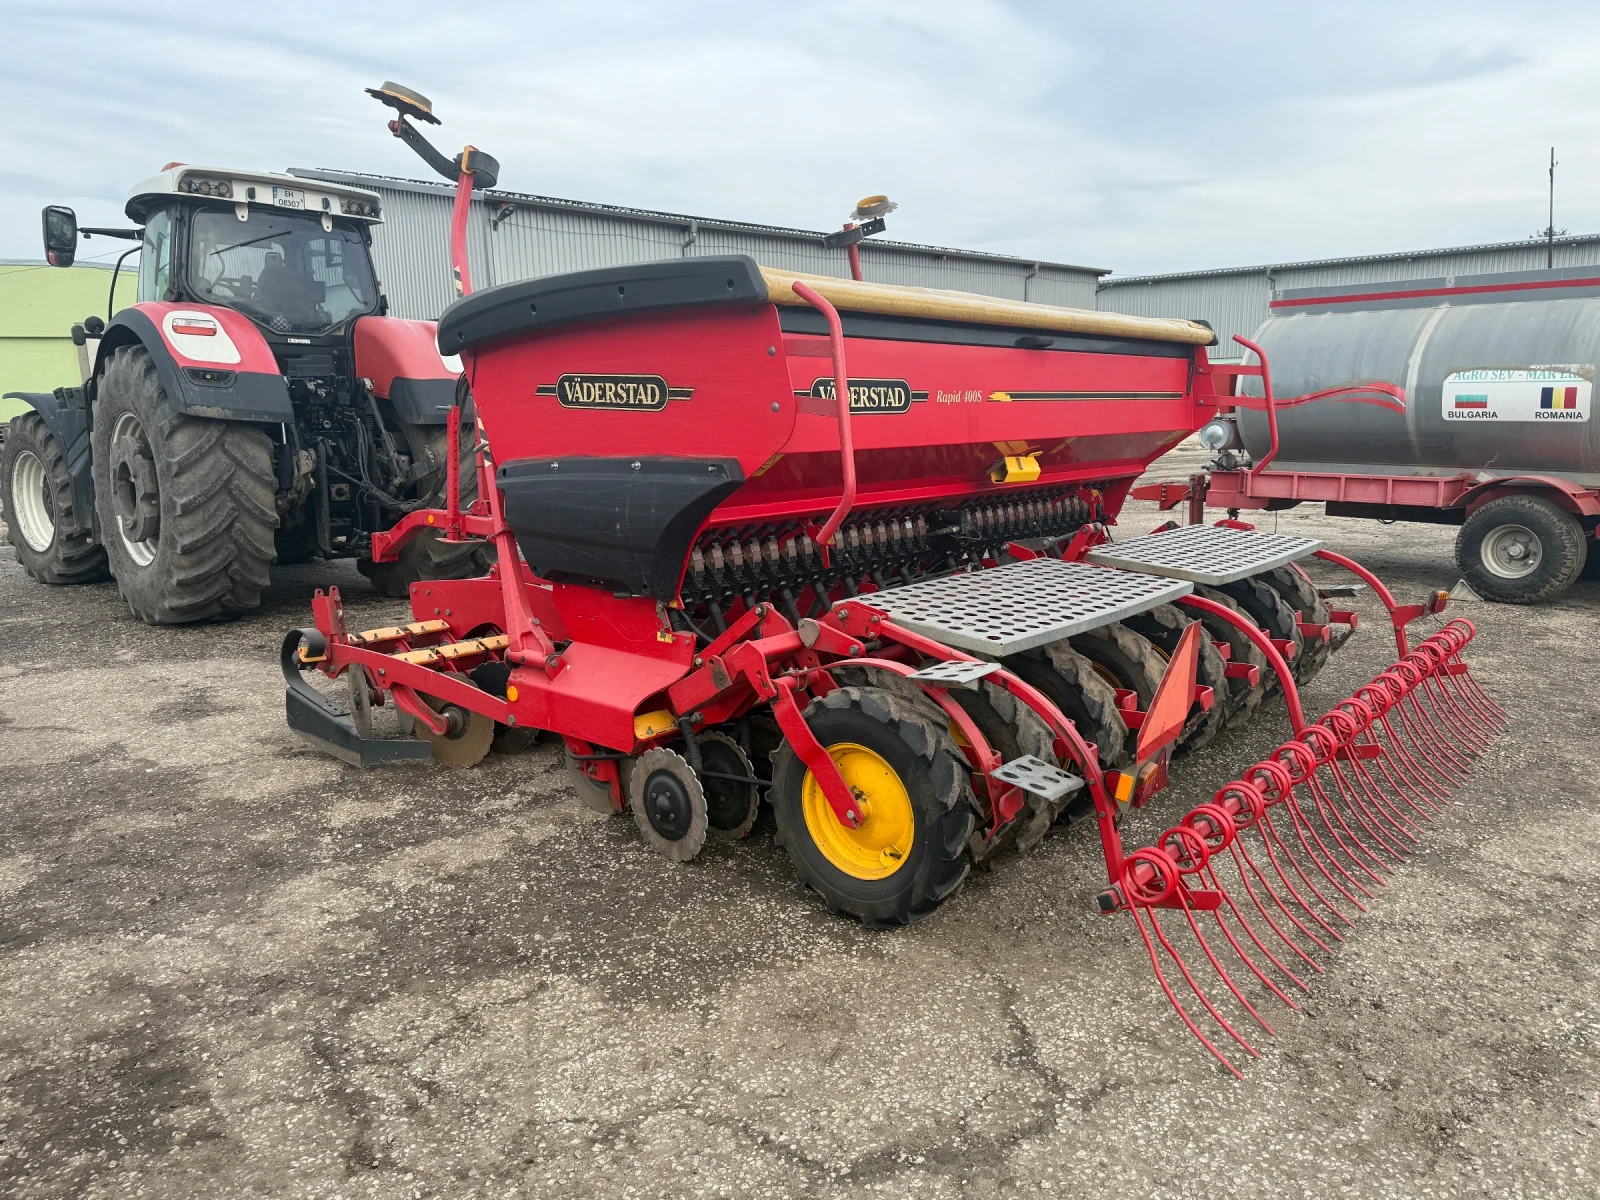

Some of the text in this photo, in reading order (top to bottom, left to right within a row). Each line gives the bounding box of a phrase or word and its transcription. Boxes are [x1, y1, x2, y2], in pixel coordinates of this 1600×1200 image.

[285, 190, 294, 198] EH
[279, 199, 300, 208] 08307
[1453, 370, 1488, 380] AGRO
[1490, 370, 1514, 380] SEV
[1525, 370, 1557, 380] MAR
[563, 377, 660, 405] VÄDERSTAD
[936, 389, 983, 406] Rapid 400S
[1447, 410, 1498, 419] BULGARIA
[1535, 411, 1583, 420] ROMANIA
